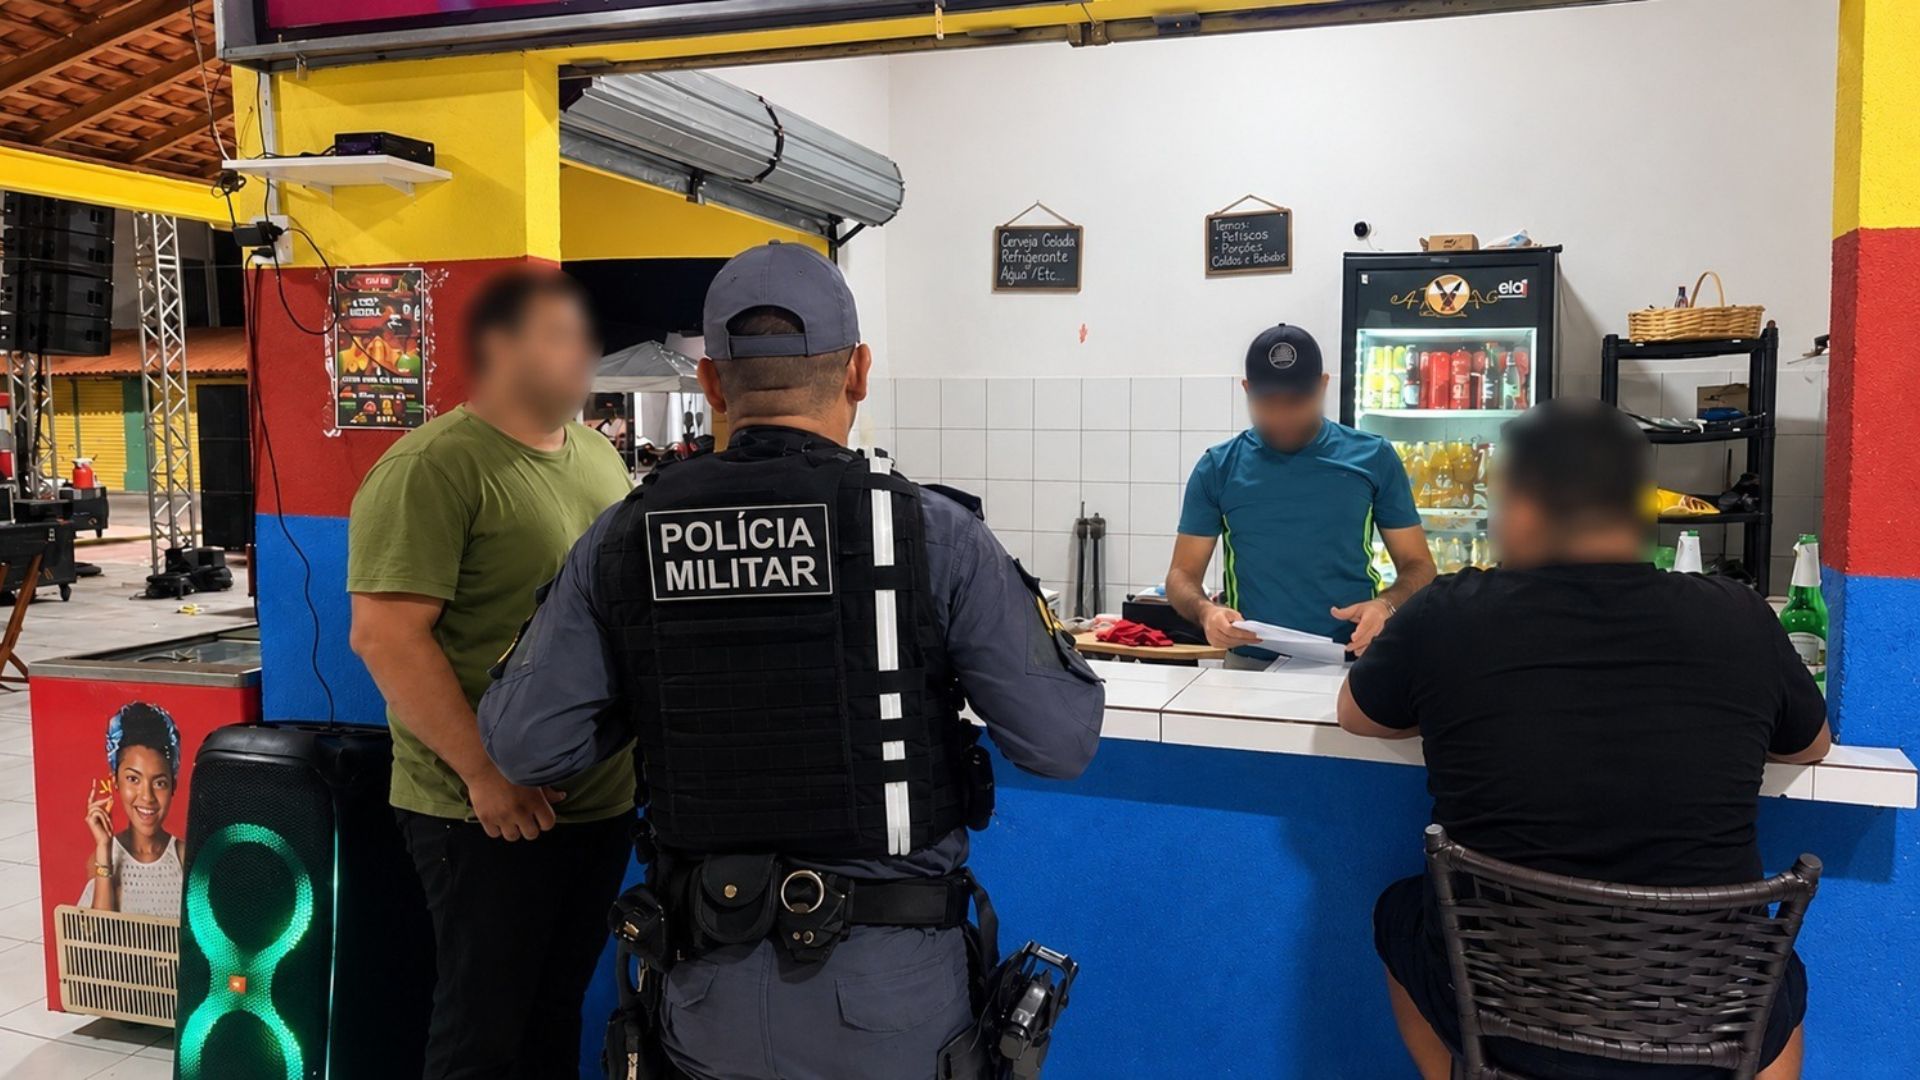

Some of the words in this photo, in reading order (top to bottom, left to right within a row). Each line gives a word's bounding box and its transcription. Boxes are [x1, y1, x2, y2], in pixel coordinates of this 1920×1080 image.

[1001, 248, 1068, 270] Refrigerante
[660, 511, 816, 554] POLÍCIA
[665, 555, 818, 591] MILITAR
